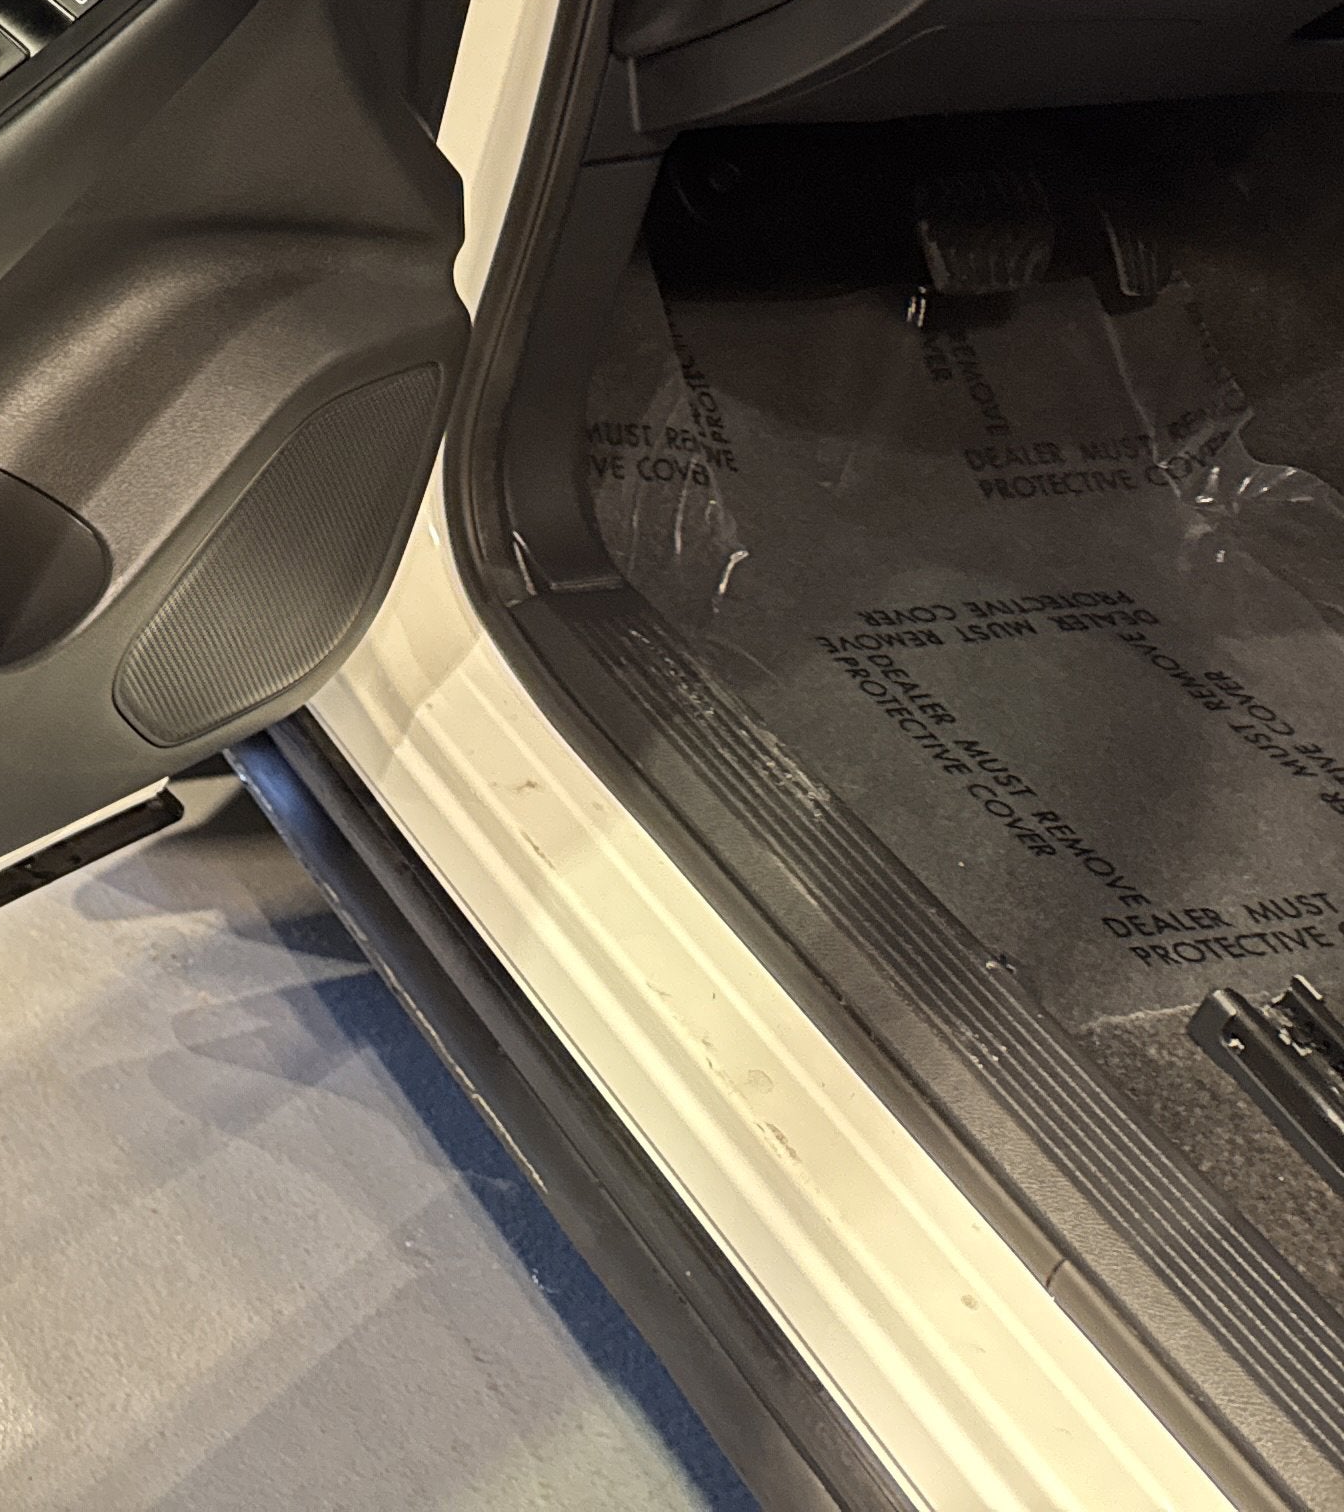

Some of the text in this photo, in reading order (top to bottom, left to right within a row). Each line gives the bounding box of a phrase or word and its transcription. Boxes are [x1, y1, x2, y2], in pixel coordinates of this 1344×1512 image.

[965, 441, 1067, 472] DEALER
[977, 469, 1139, 500] PROTECTIVE
[814, 609, 1160, 655] DEALER MUST REMOVE
[857, 590, 1136, 627] PROTECTIVE COVER
[1117, 631, 1232, 711] REMOVE
[1204, 671, 1295, 737] COVER
[833, 656, 1057, 857] PROTECTIVE COVER
[1228, 721, 1319, 777] MUST
[867, 653, 1153, 908] DEALER MUST REMOVE
[1102, 892, 1341, 940] DEALER MUST
[1129, 925, 1336, 967] PROTECTIVE
